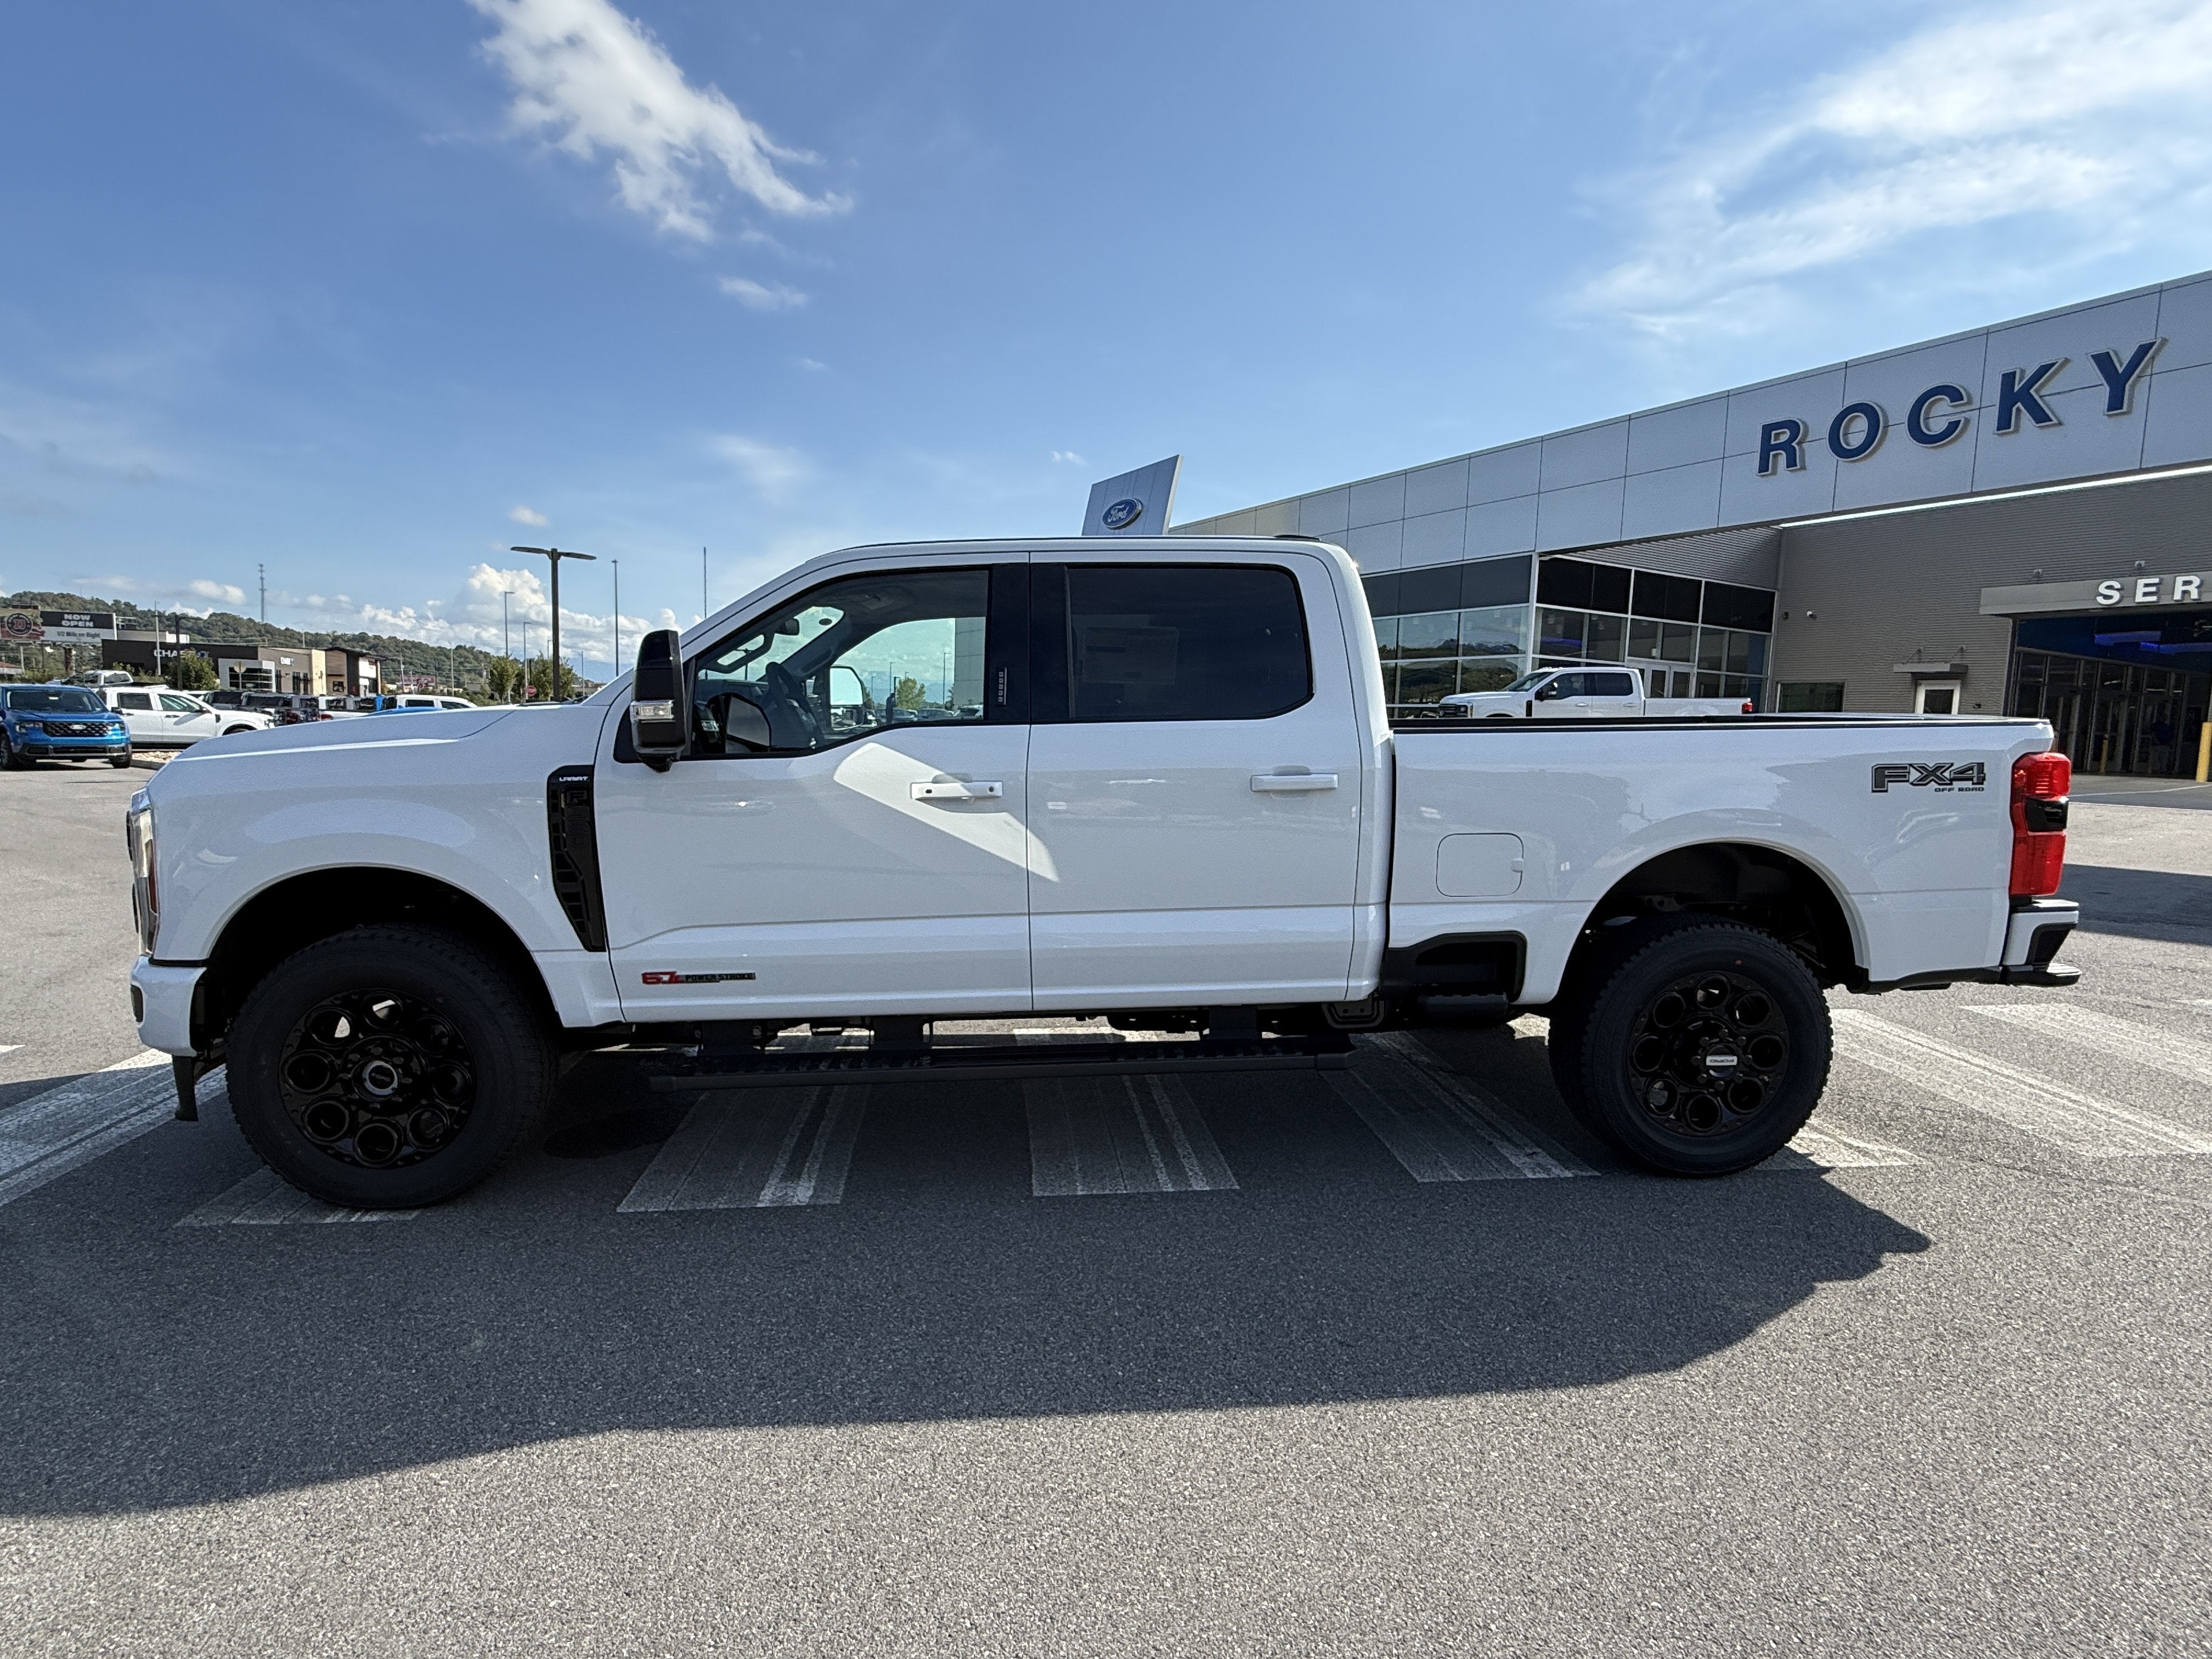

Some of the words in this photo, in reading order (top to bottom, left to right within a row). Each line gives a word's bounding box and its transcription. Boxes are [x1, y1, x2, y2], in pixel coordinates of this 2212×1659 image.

[1757, 336, 2166, 476] ROCKY
[1108, 504, 1129, 522] Ford
[2096, 575, 2202, 605] SER
[1871, 762, 1985, 793] FX4
